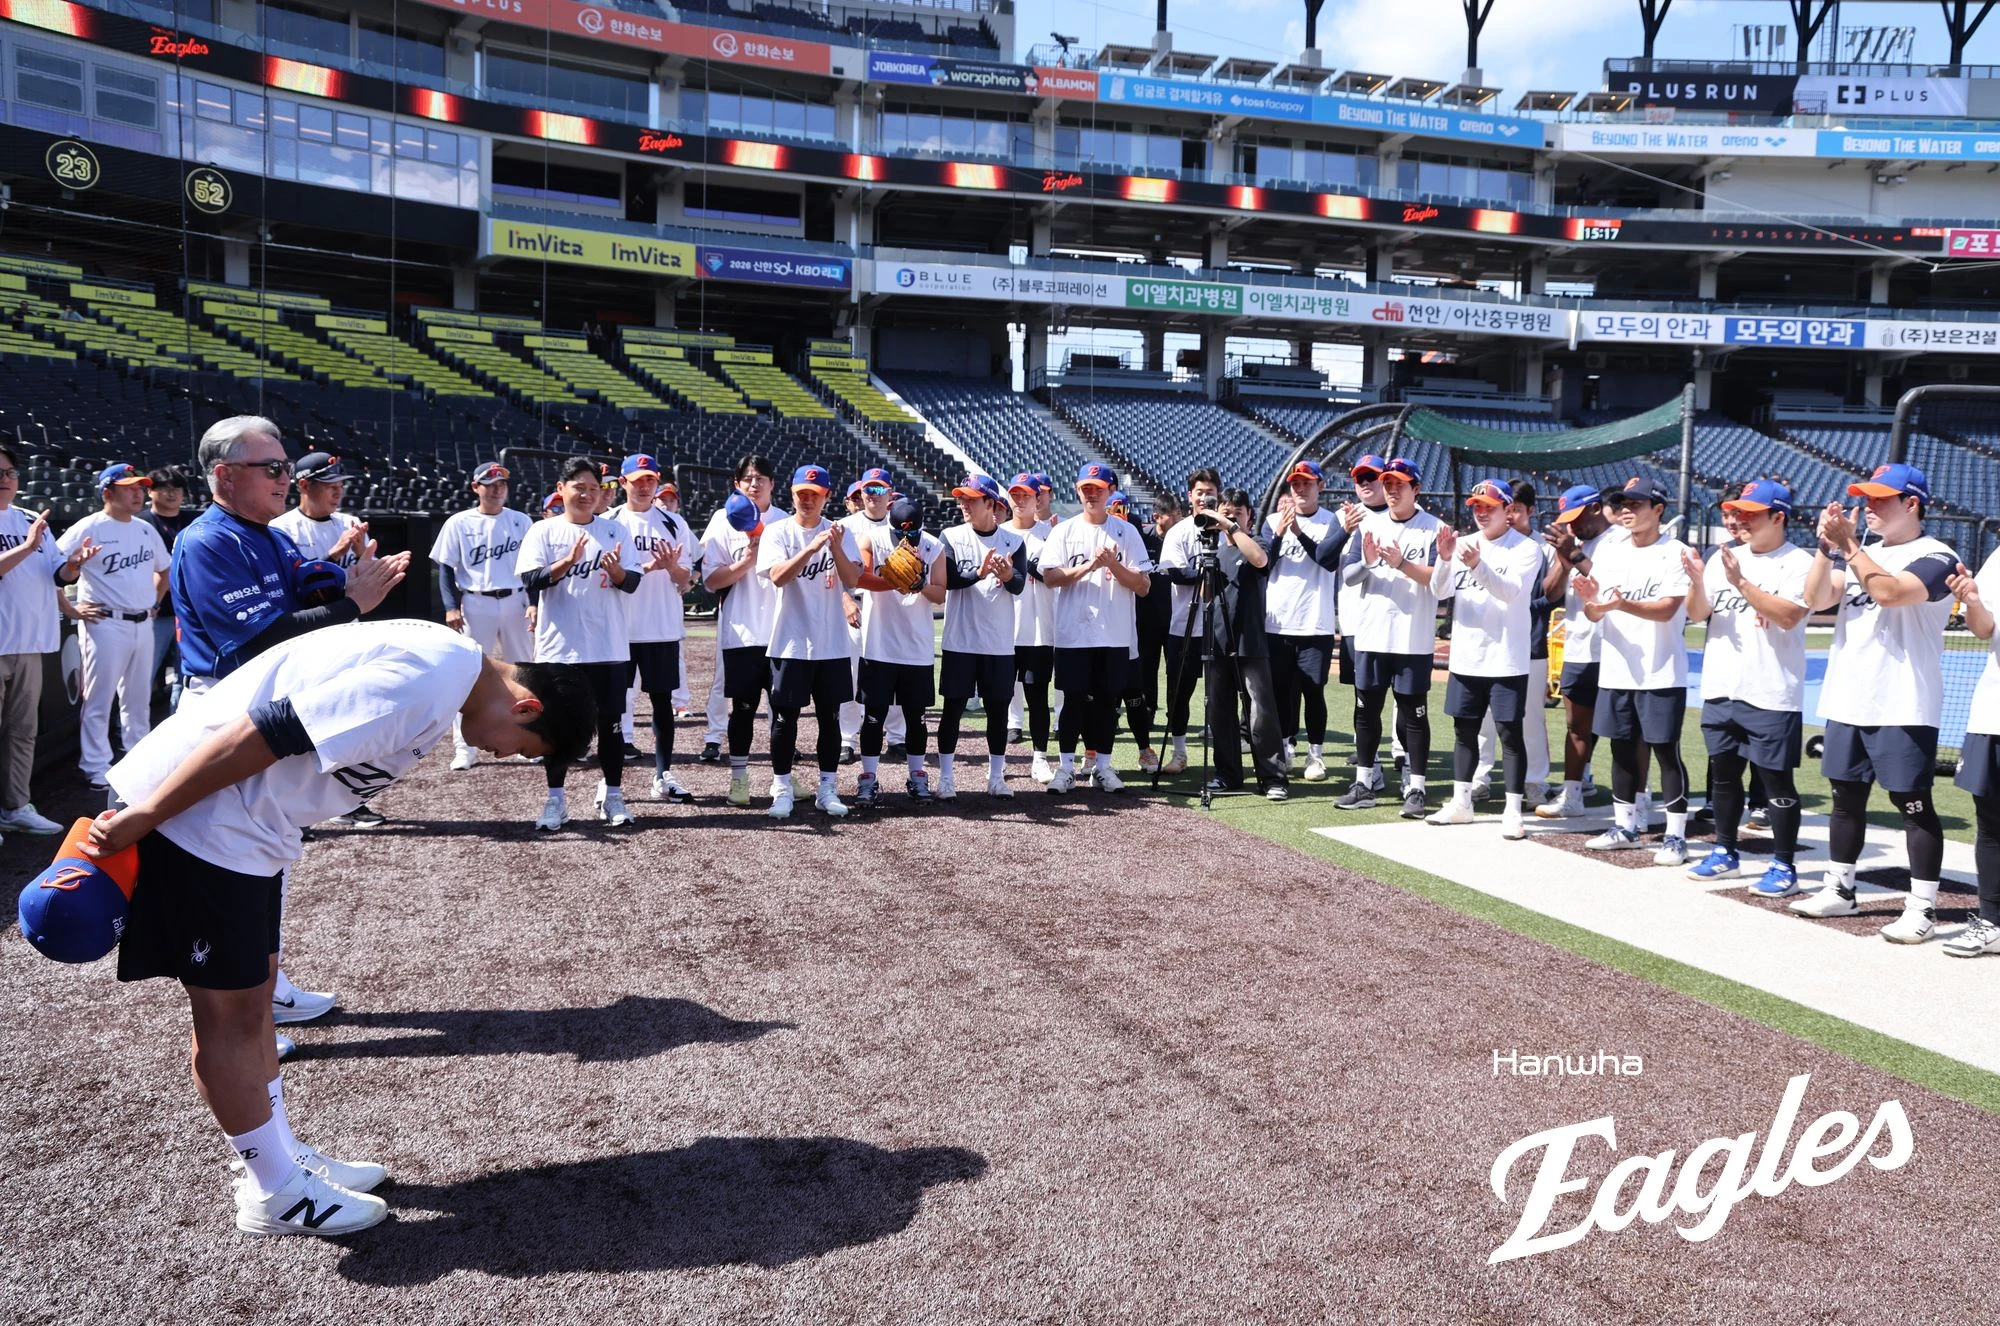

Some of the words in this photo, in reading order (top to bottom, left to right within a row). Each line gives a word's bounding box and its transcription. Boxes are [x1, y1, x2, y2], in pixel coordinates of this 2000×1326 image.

[609, 18, 663, 42] 한화손보
[151, 37, 208, 57] Eagles
[744, 41, 795, 62] 한화손보
[872, 61, 926, 76] JOBKOREA
[951, 71, 1021, 87] worxphere
[1042, 76, 1096, 93] ALBAMON
[1133, 83, 1167, 99] 얼굴로
[1875, 90, 1929, 102] PLUS
[1243, 96, 1265, 108] toss
[1265, 98, 1305, 113] facepay
[1459, 119, 1494, 135] arena
[639, 133, 683, 151] Eagles
[1721, 136, 1759, 147] arena
[56, 154, 90, 179] 23
[1043, 176, 1083, 191] Eagles
[194, 180, 225, 206] 52
[1403, 207, 1438, 222] Eagles
[1585, 227, 1620, 240] 15:17
[753, 261, 773, 273] 신한
[795, 264, 820, 277] KBO
[821, 266, 841, 279] 리그
[920, 271, 972, 284] BLUE
[1018, 277, 1107, 299] 블루코퍼레이션
[1132, 283, 1238, 310] 이엘치과병원
[1250, 292, 1350, 318] 이엘치과병원
[1594, 317, 1660, 340] 모두의
[1668, 317, 1712, 341] 안과
[1734, 321, 1801, 345] 모두의
[1806, 321, 1855, 346] 안과
[222, 584, 262, 604] 한화오션
[1905, 800, 1923, 814] 33
[279, 1197, 343, 1229] N
